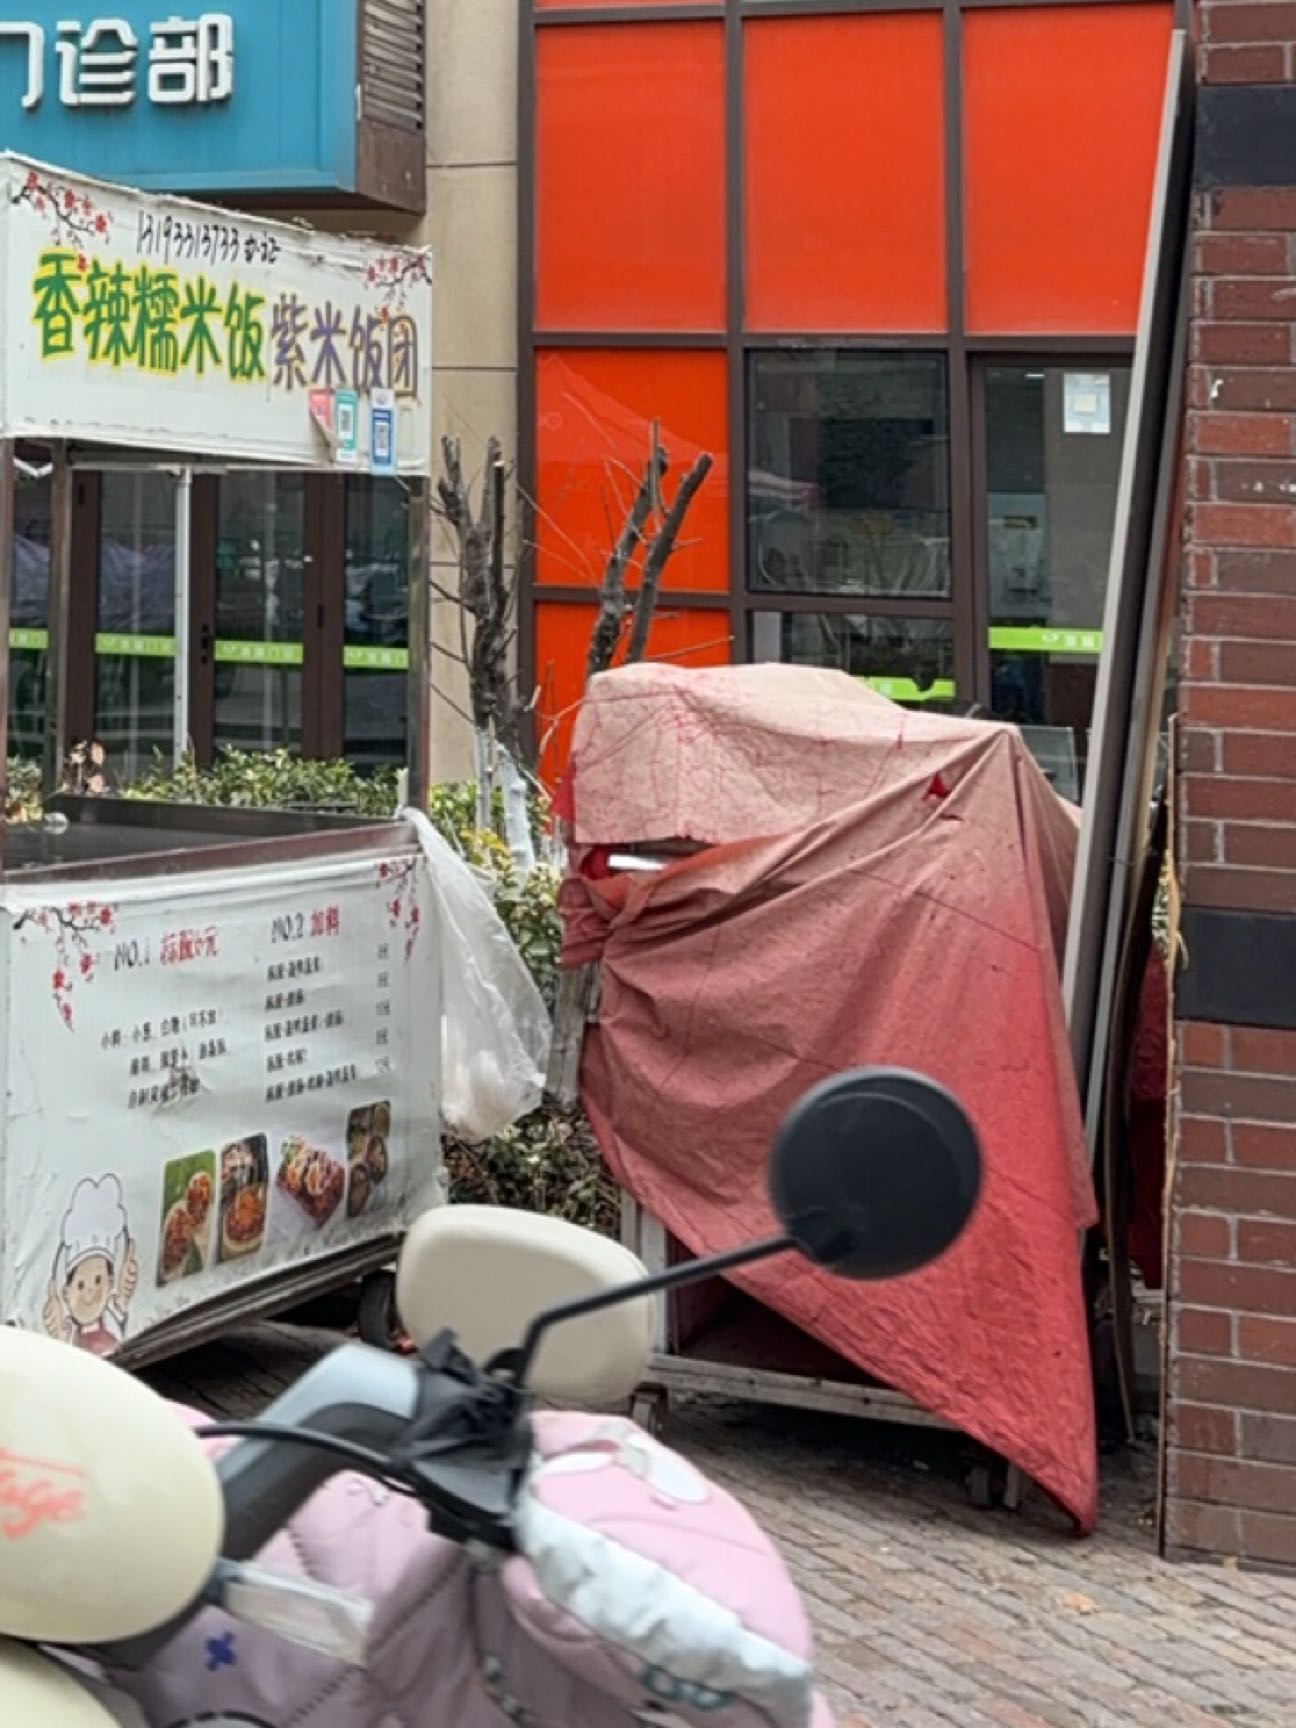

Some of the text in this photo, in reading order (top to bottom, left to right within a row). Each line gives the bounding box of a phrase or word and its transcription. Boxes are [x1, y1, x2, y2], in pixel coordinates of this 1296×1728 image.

[33, 249, 421, 399] 香辣糯米饭 紫米饭团
